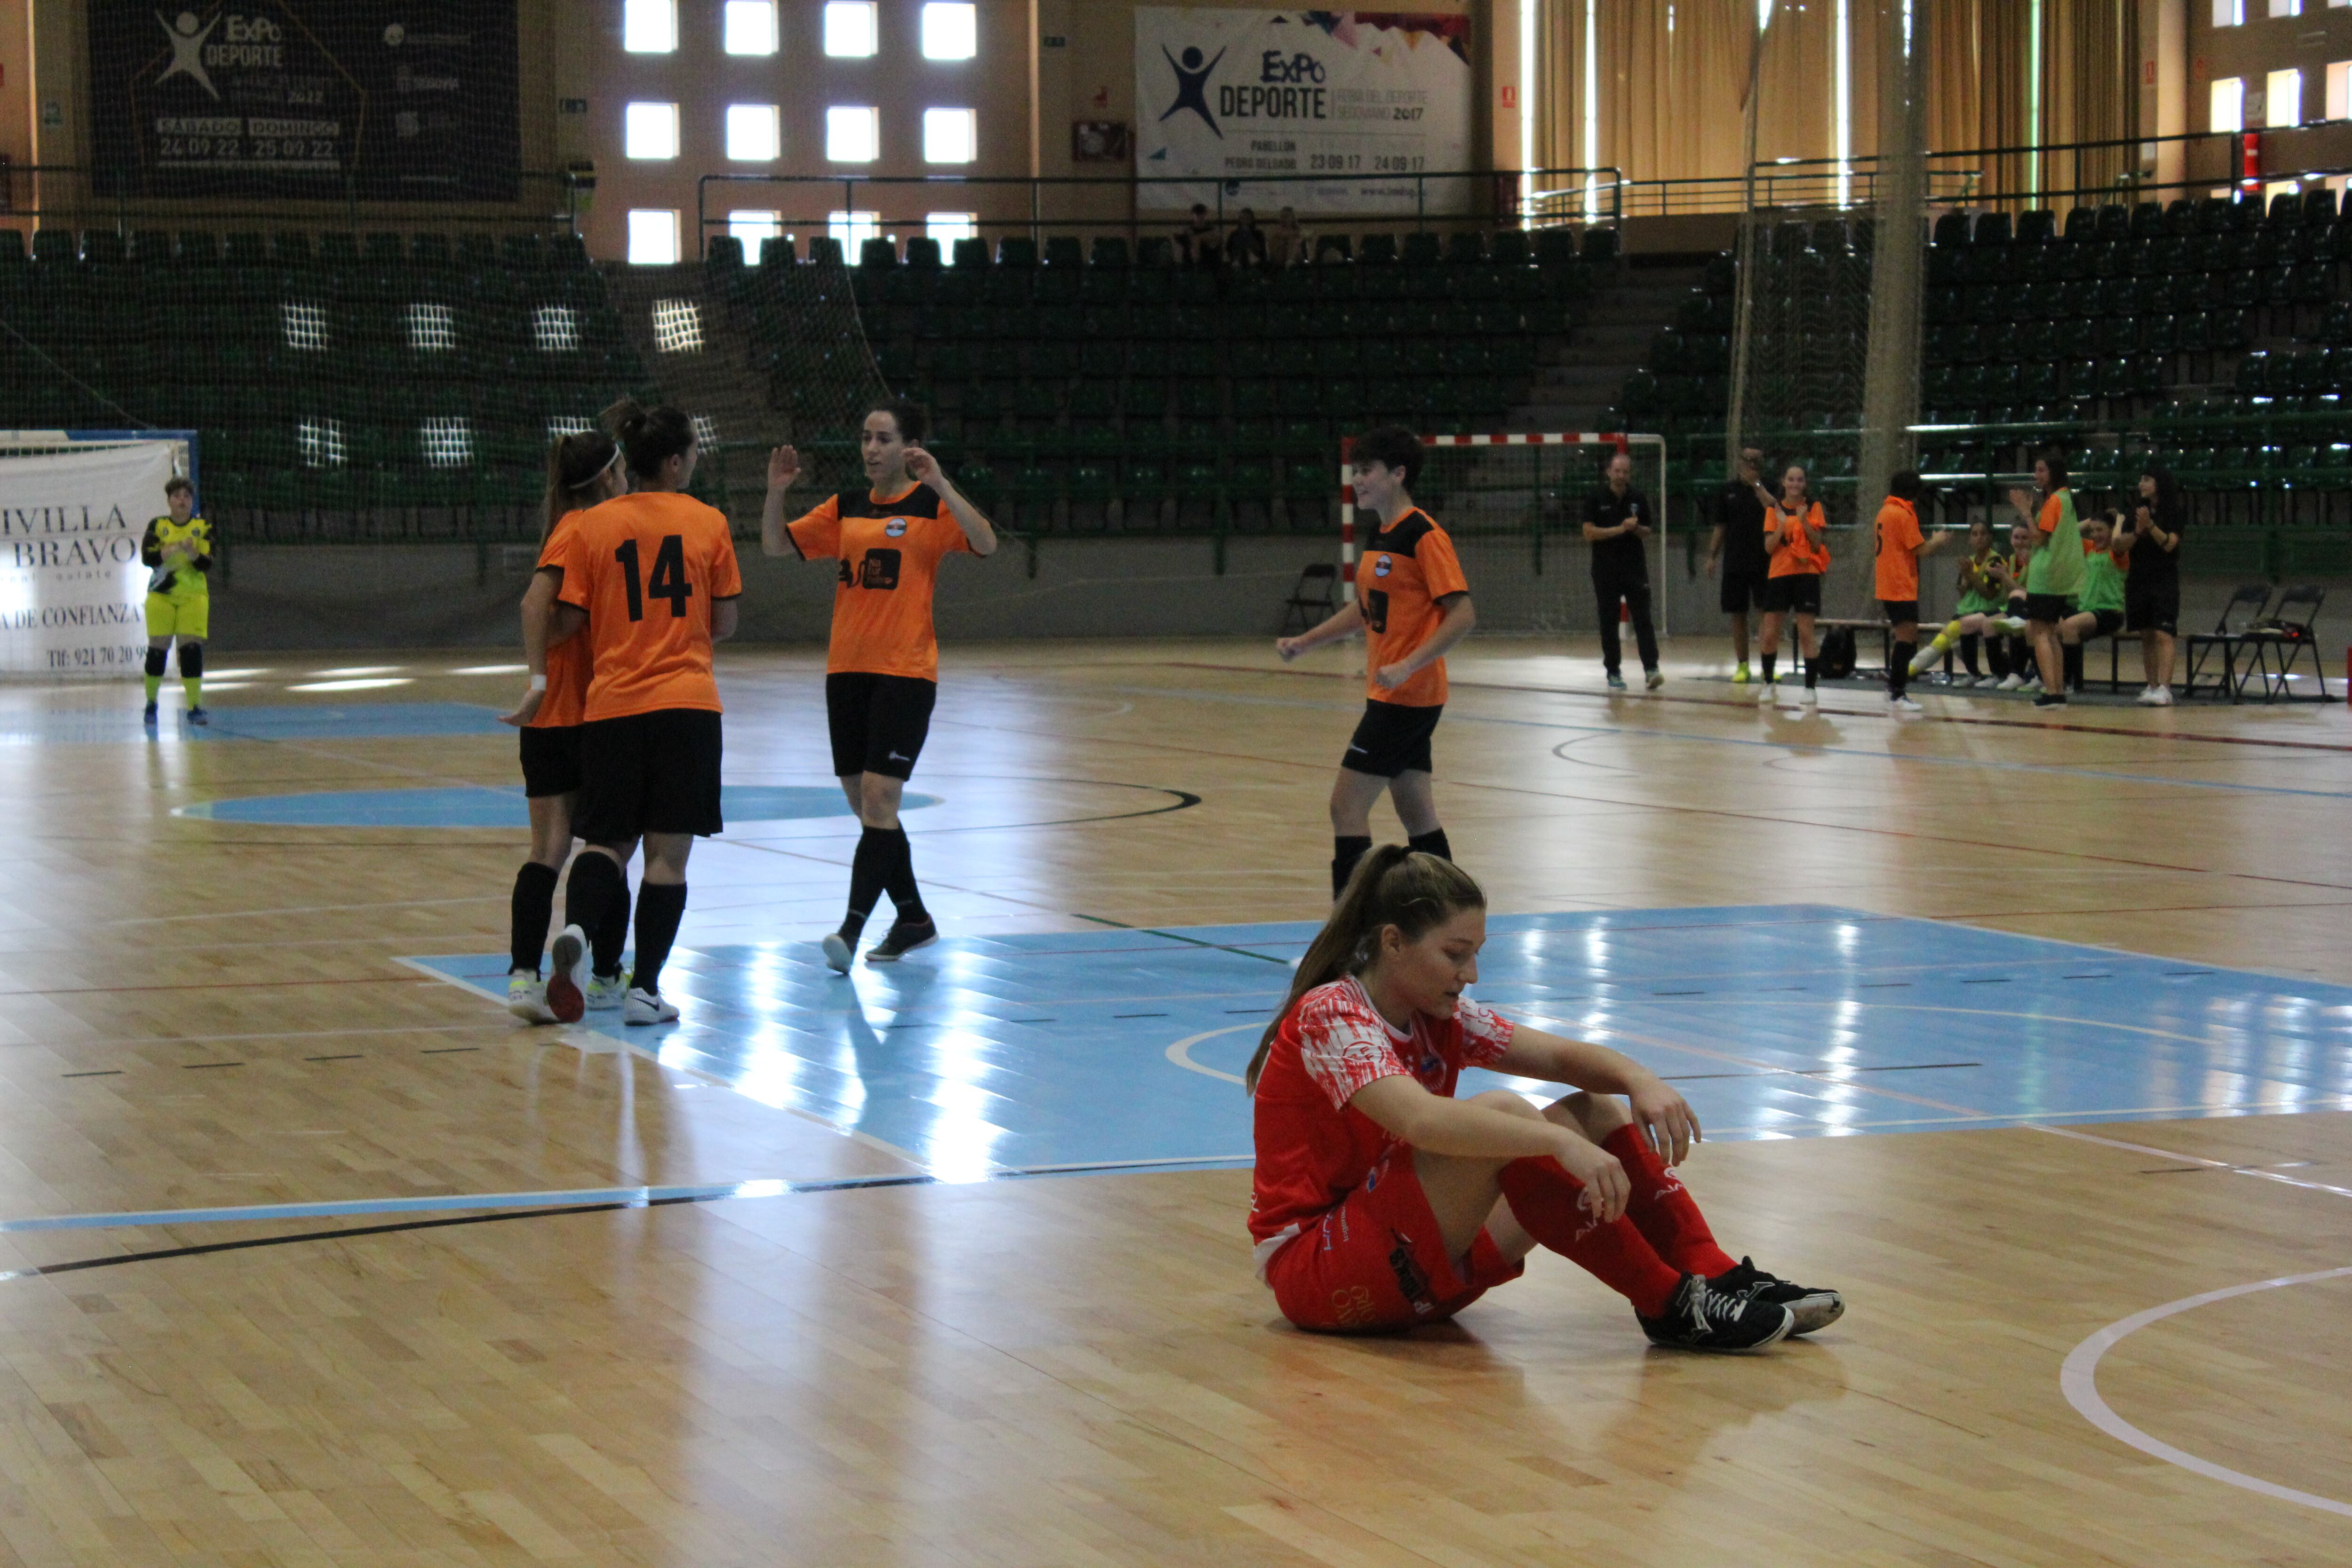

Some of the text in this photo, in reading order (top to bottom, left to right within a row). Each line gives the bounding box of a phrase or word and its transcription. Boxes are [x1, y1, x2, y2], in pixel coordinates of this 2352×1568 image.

[207, 45, 284, 67] DEPORTE
[1220, 85, 1326, 119] DEPORTE
[1393, 107, 1423, 120] 2017
[14, 535, 136, 567] BRAVO
[615, 534, 692, 622] 14
[15, 609, 37, 629] DE
[74, 645, 95, 665] 921
[100, 645, 114, 663] 70
[119, 645, 133, 662] 20
